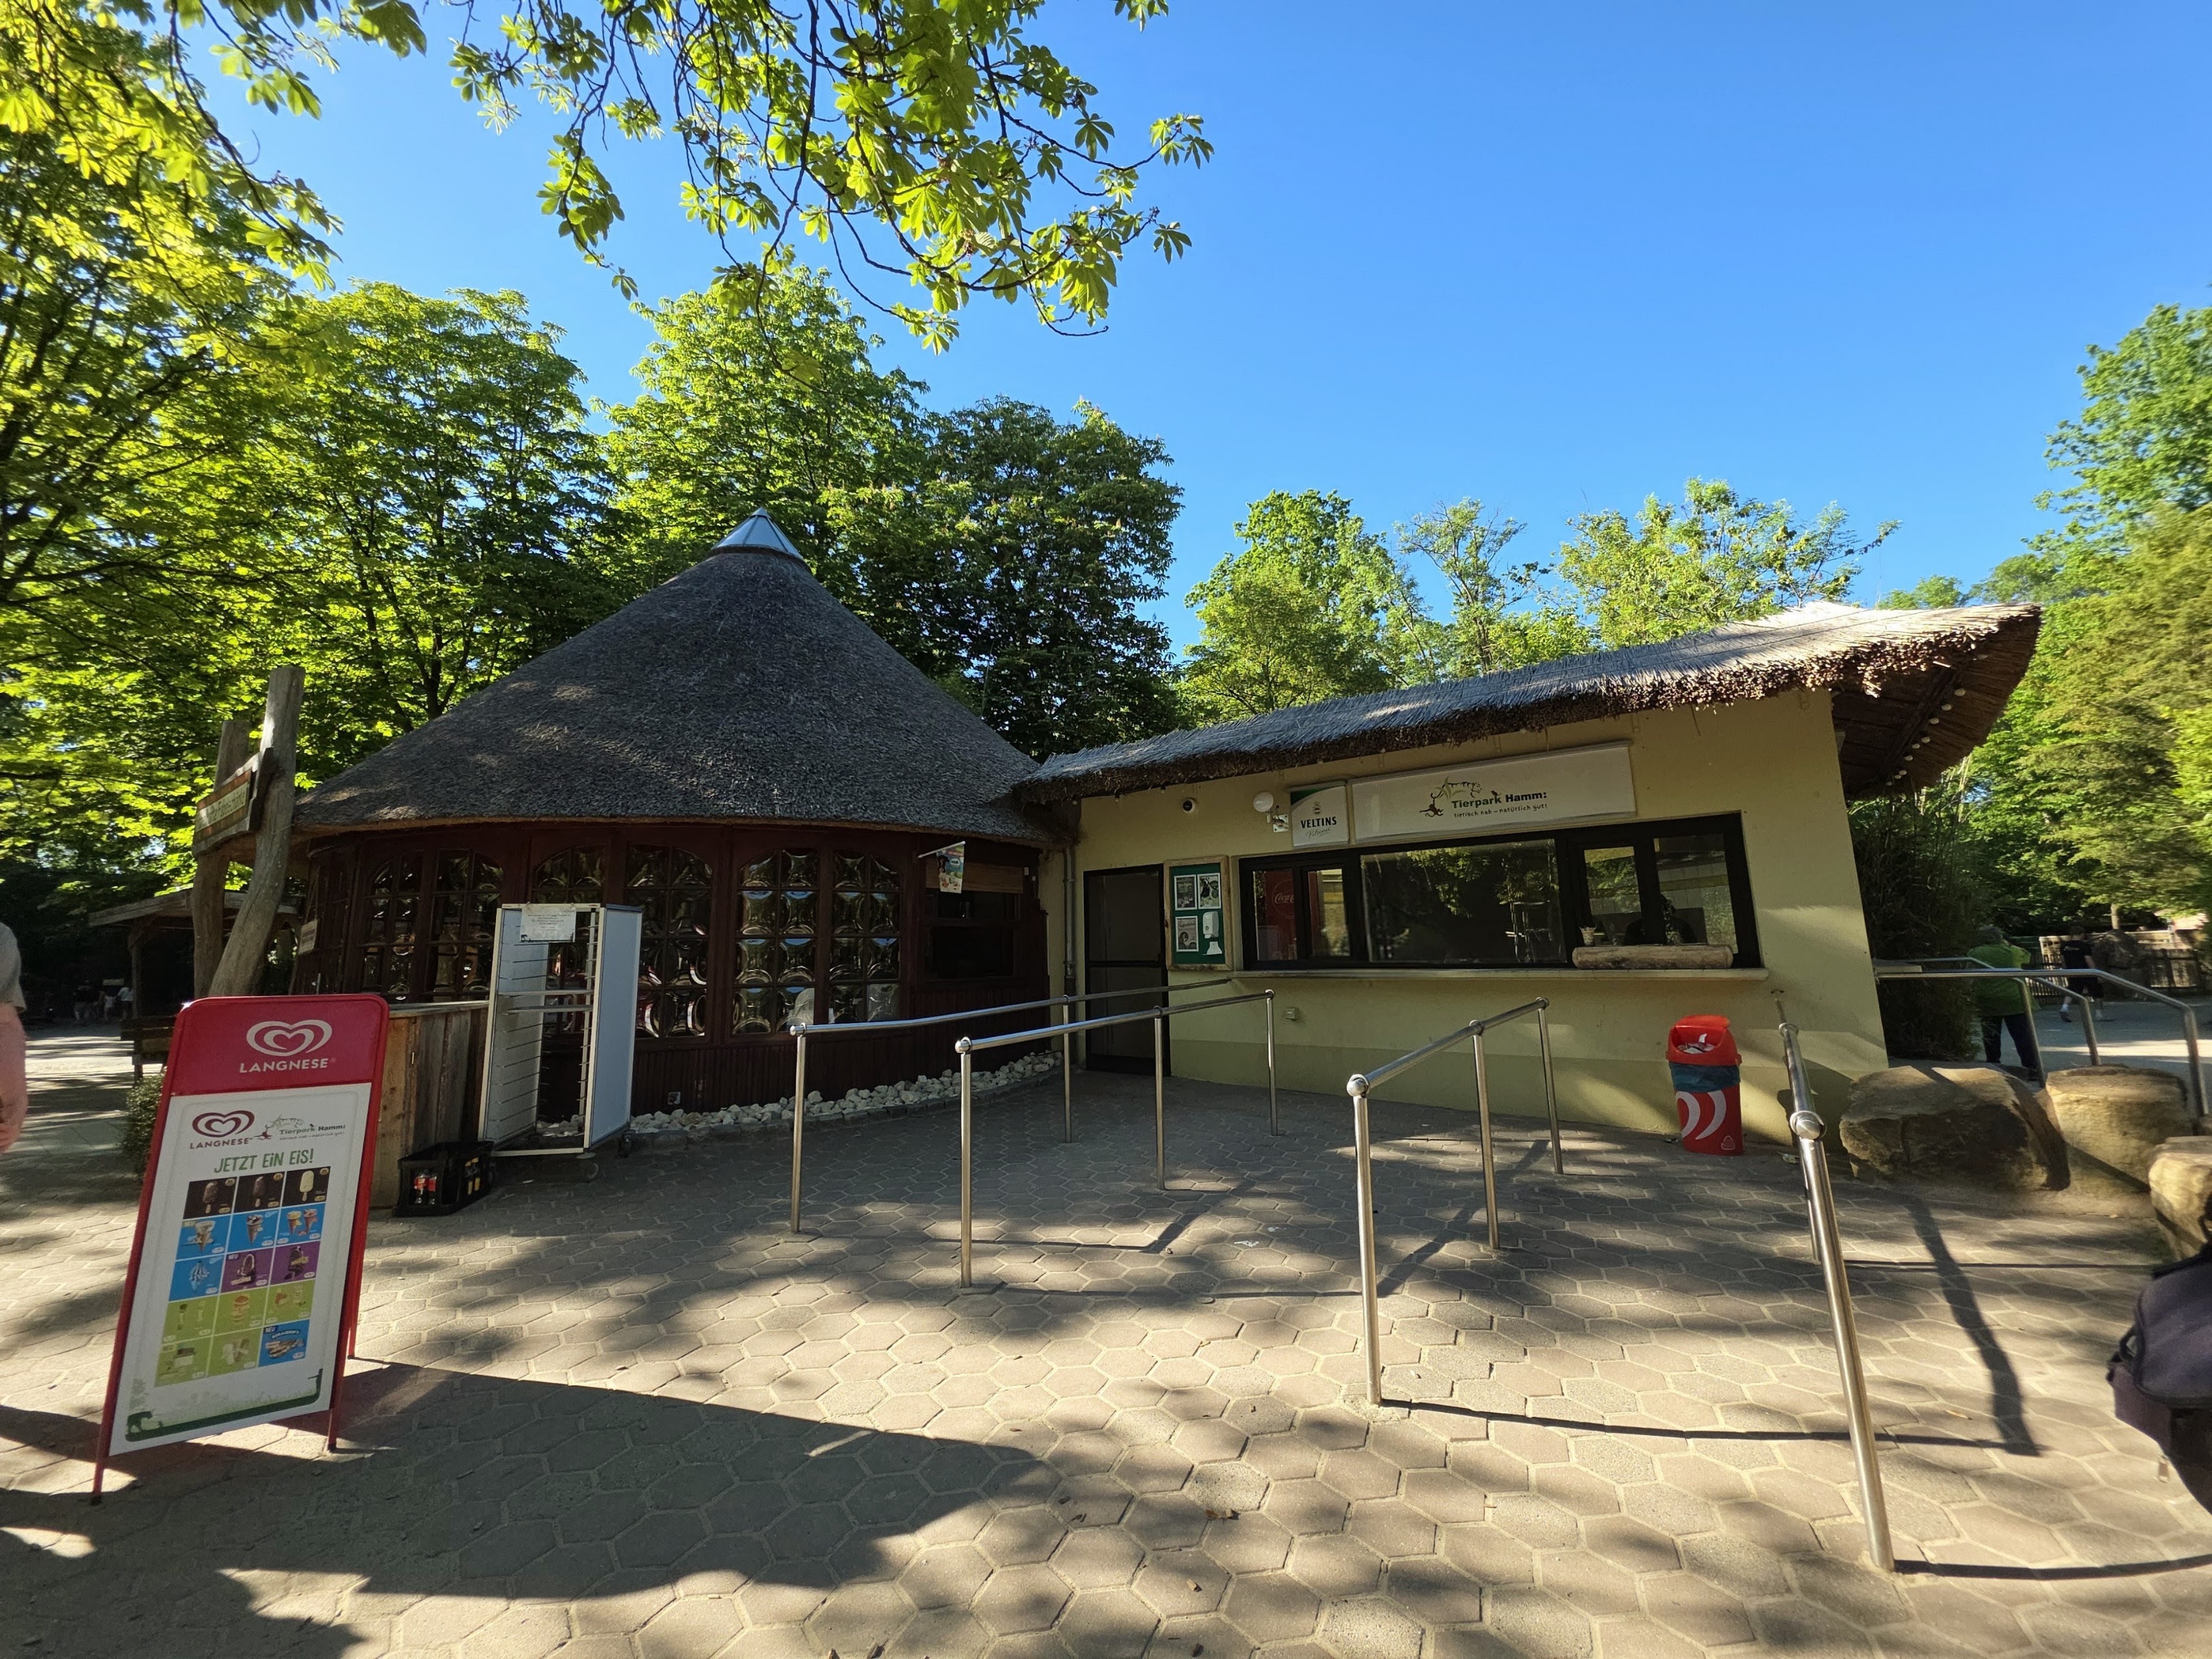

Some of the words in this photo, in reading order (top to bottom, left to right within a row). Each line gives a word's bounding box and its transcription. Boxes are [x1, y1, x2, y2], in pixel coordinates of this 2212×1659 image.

[1451, 796, 1502, 809] Tierpark
[1506, 792, 1547, 803] Hamm:
[1499, 805, 1531, 813] natürlich
[1300, 816, 1337, 829] VELTINS
[239, 1058, 329, 1074] LANGNESE
[279, 1127, 315, 1135] Tierpark
[189, 1137, 249, 1150] LANGNESE
[214, 1155, 258, 1173] JETZT
